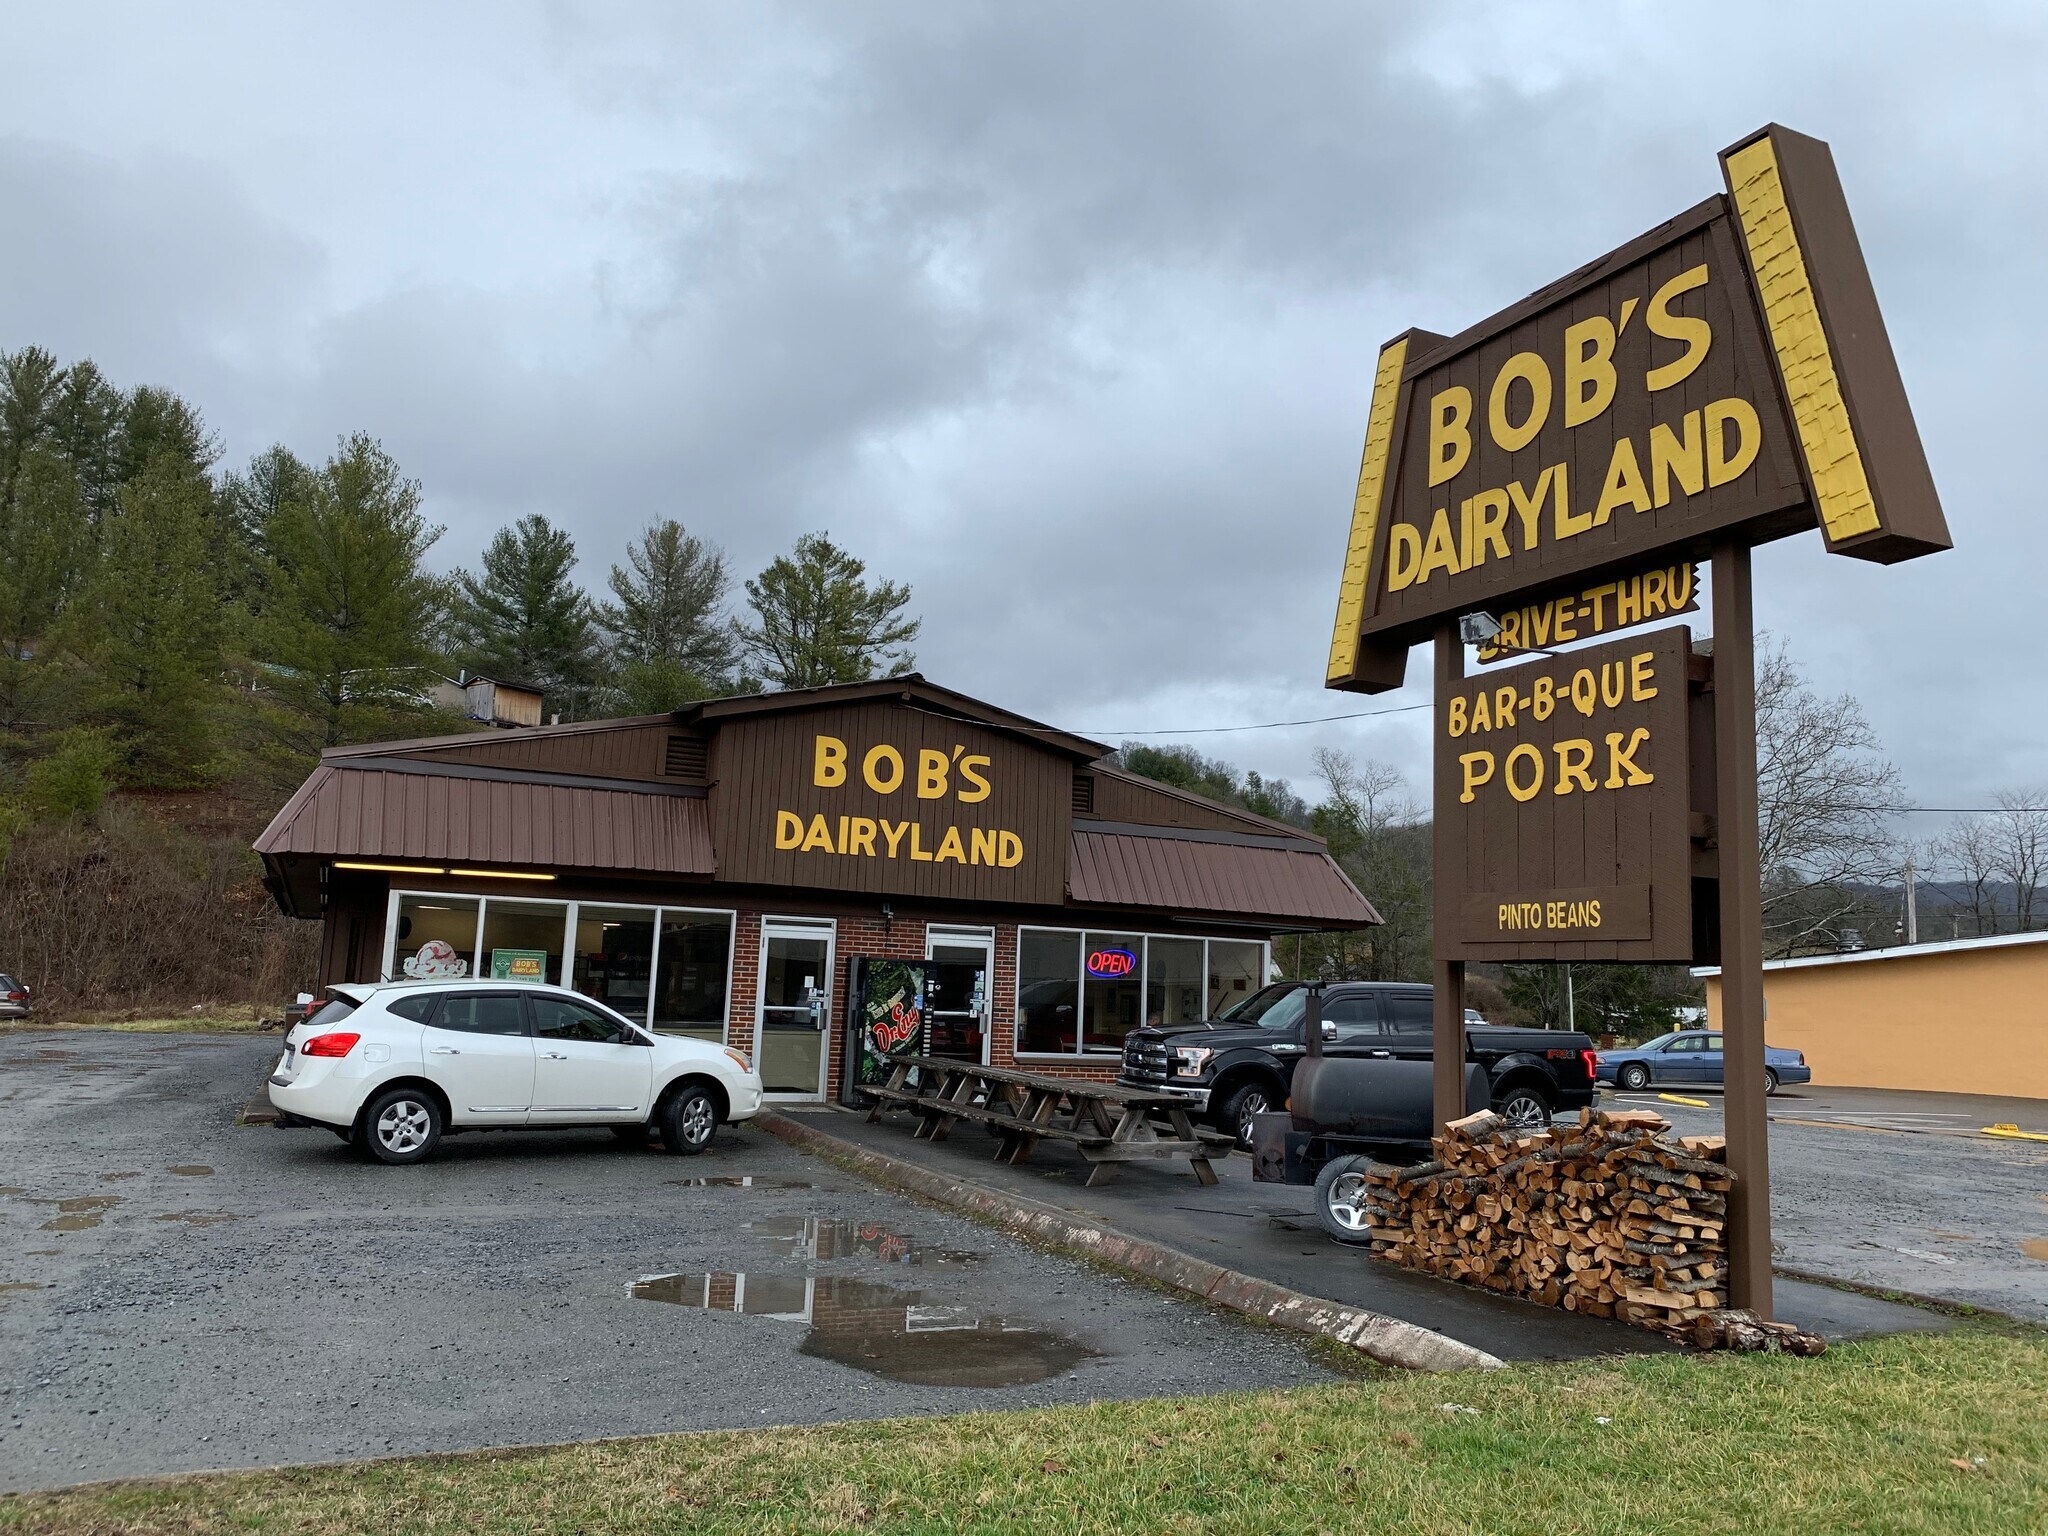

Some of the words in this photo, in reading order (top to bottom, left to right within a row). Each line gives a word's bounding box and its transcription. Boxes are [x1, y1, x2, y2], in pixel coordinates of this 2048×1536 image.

[1427, 263, 1712, 488] BOB'S
[1387, 397, 1762, 593] DAIRYLAND
[1448, 651, 1659, 738] BAR-B-QUE
[813, 734, 991, 804] BOB'S
[1458, 727, 1654, 804] PORK
[775, 810, 1024, 868] DAIRYLAND
[1498, 902, 1542, 930] PINTO
[1547, 899, 1601, 929] BEANS
[515, 960, 537, 968] BOB'S
[1088, 951, 1132, 975] OPEN
